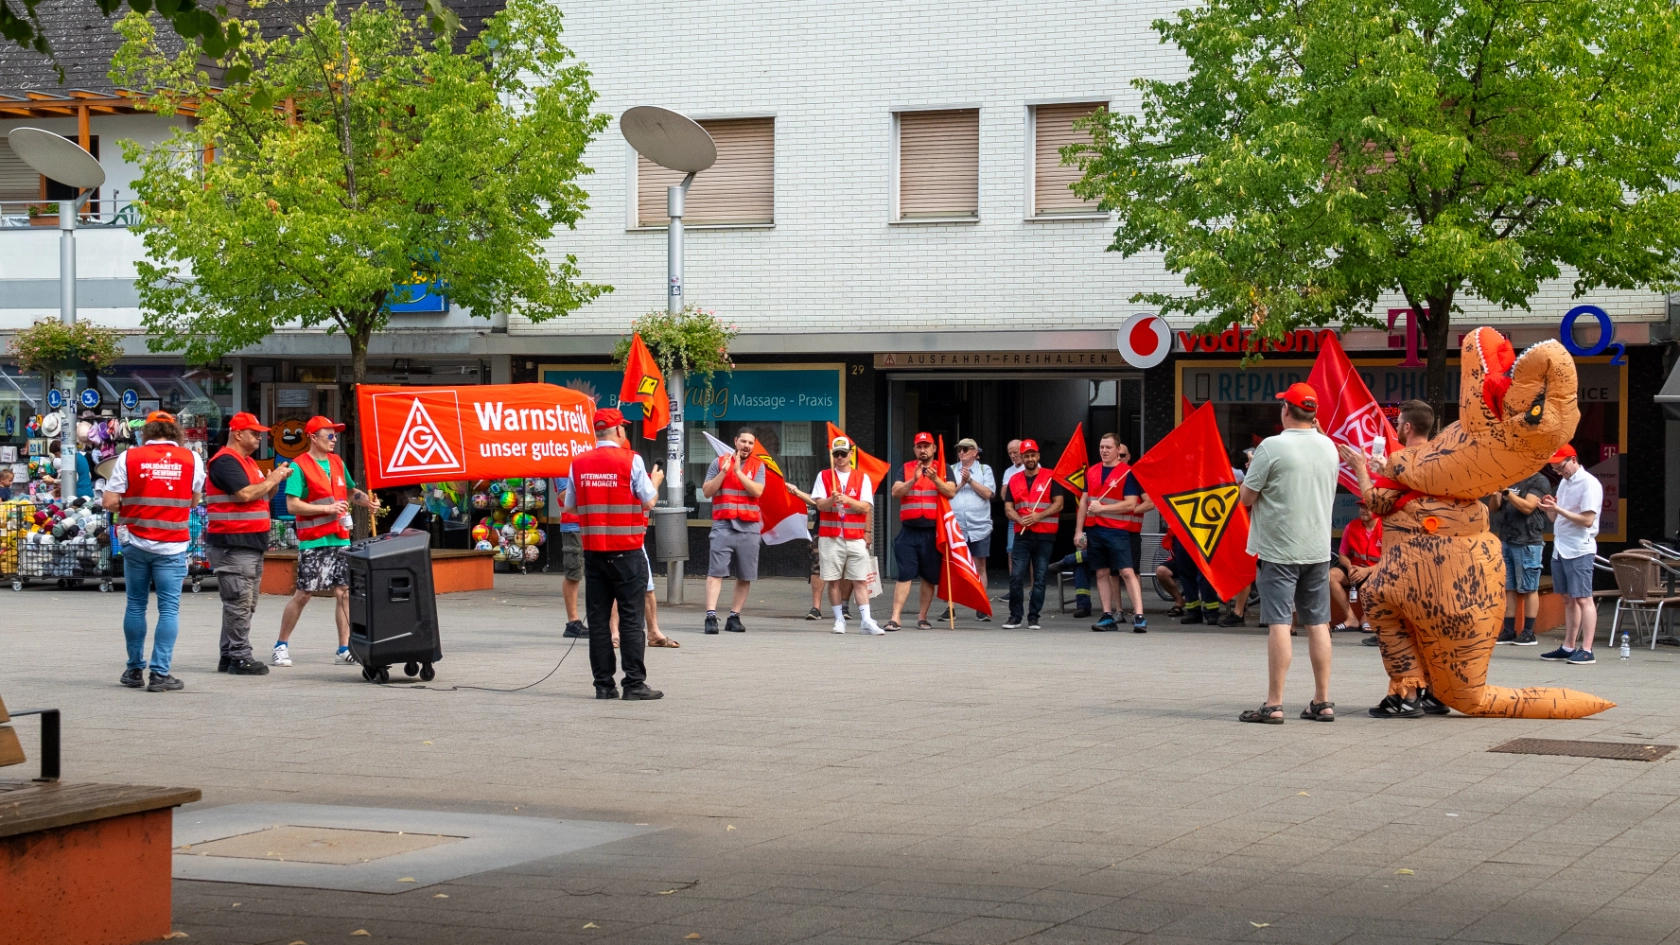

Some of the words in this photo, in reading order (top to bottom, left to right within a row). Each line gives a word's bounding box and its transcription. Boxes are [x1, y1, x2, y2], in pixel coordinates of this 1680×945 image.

[852, 364, 865, 375] 29
[733, 393, 786, 410] Massage
[798, 393, 833, 407] Praxis
[474, 402, 591, 435] Warnstreik
[480, 442, 527, 458] unser
[532, 439, 569, 461] gutes
[141, 463, 182, 471] SOLIDARITÄT
[592, 480, 618, 488] MORGEN
